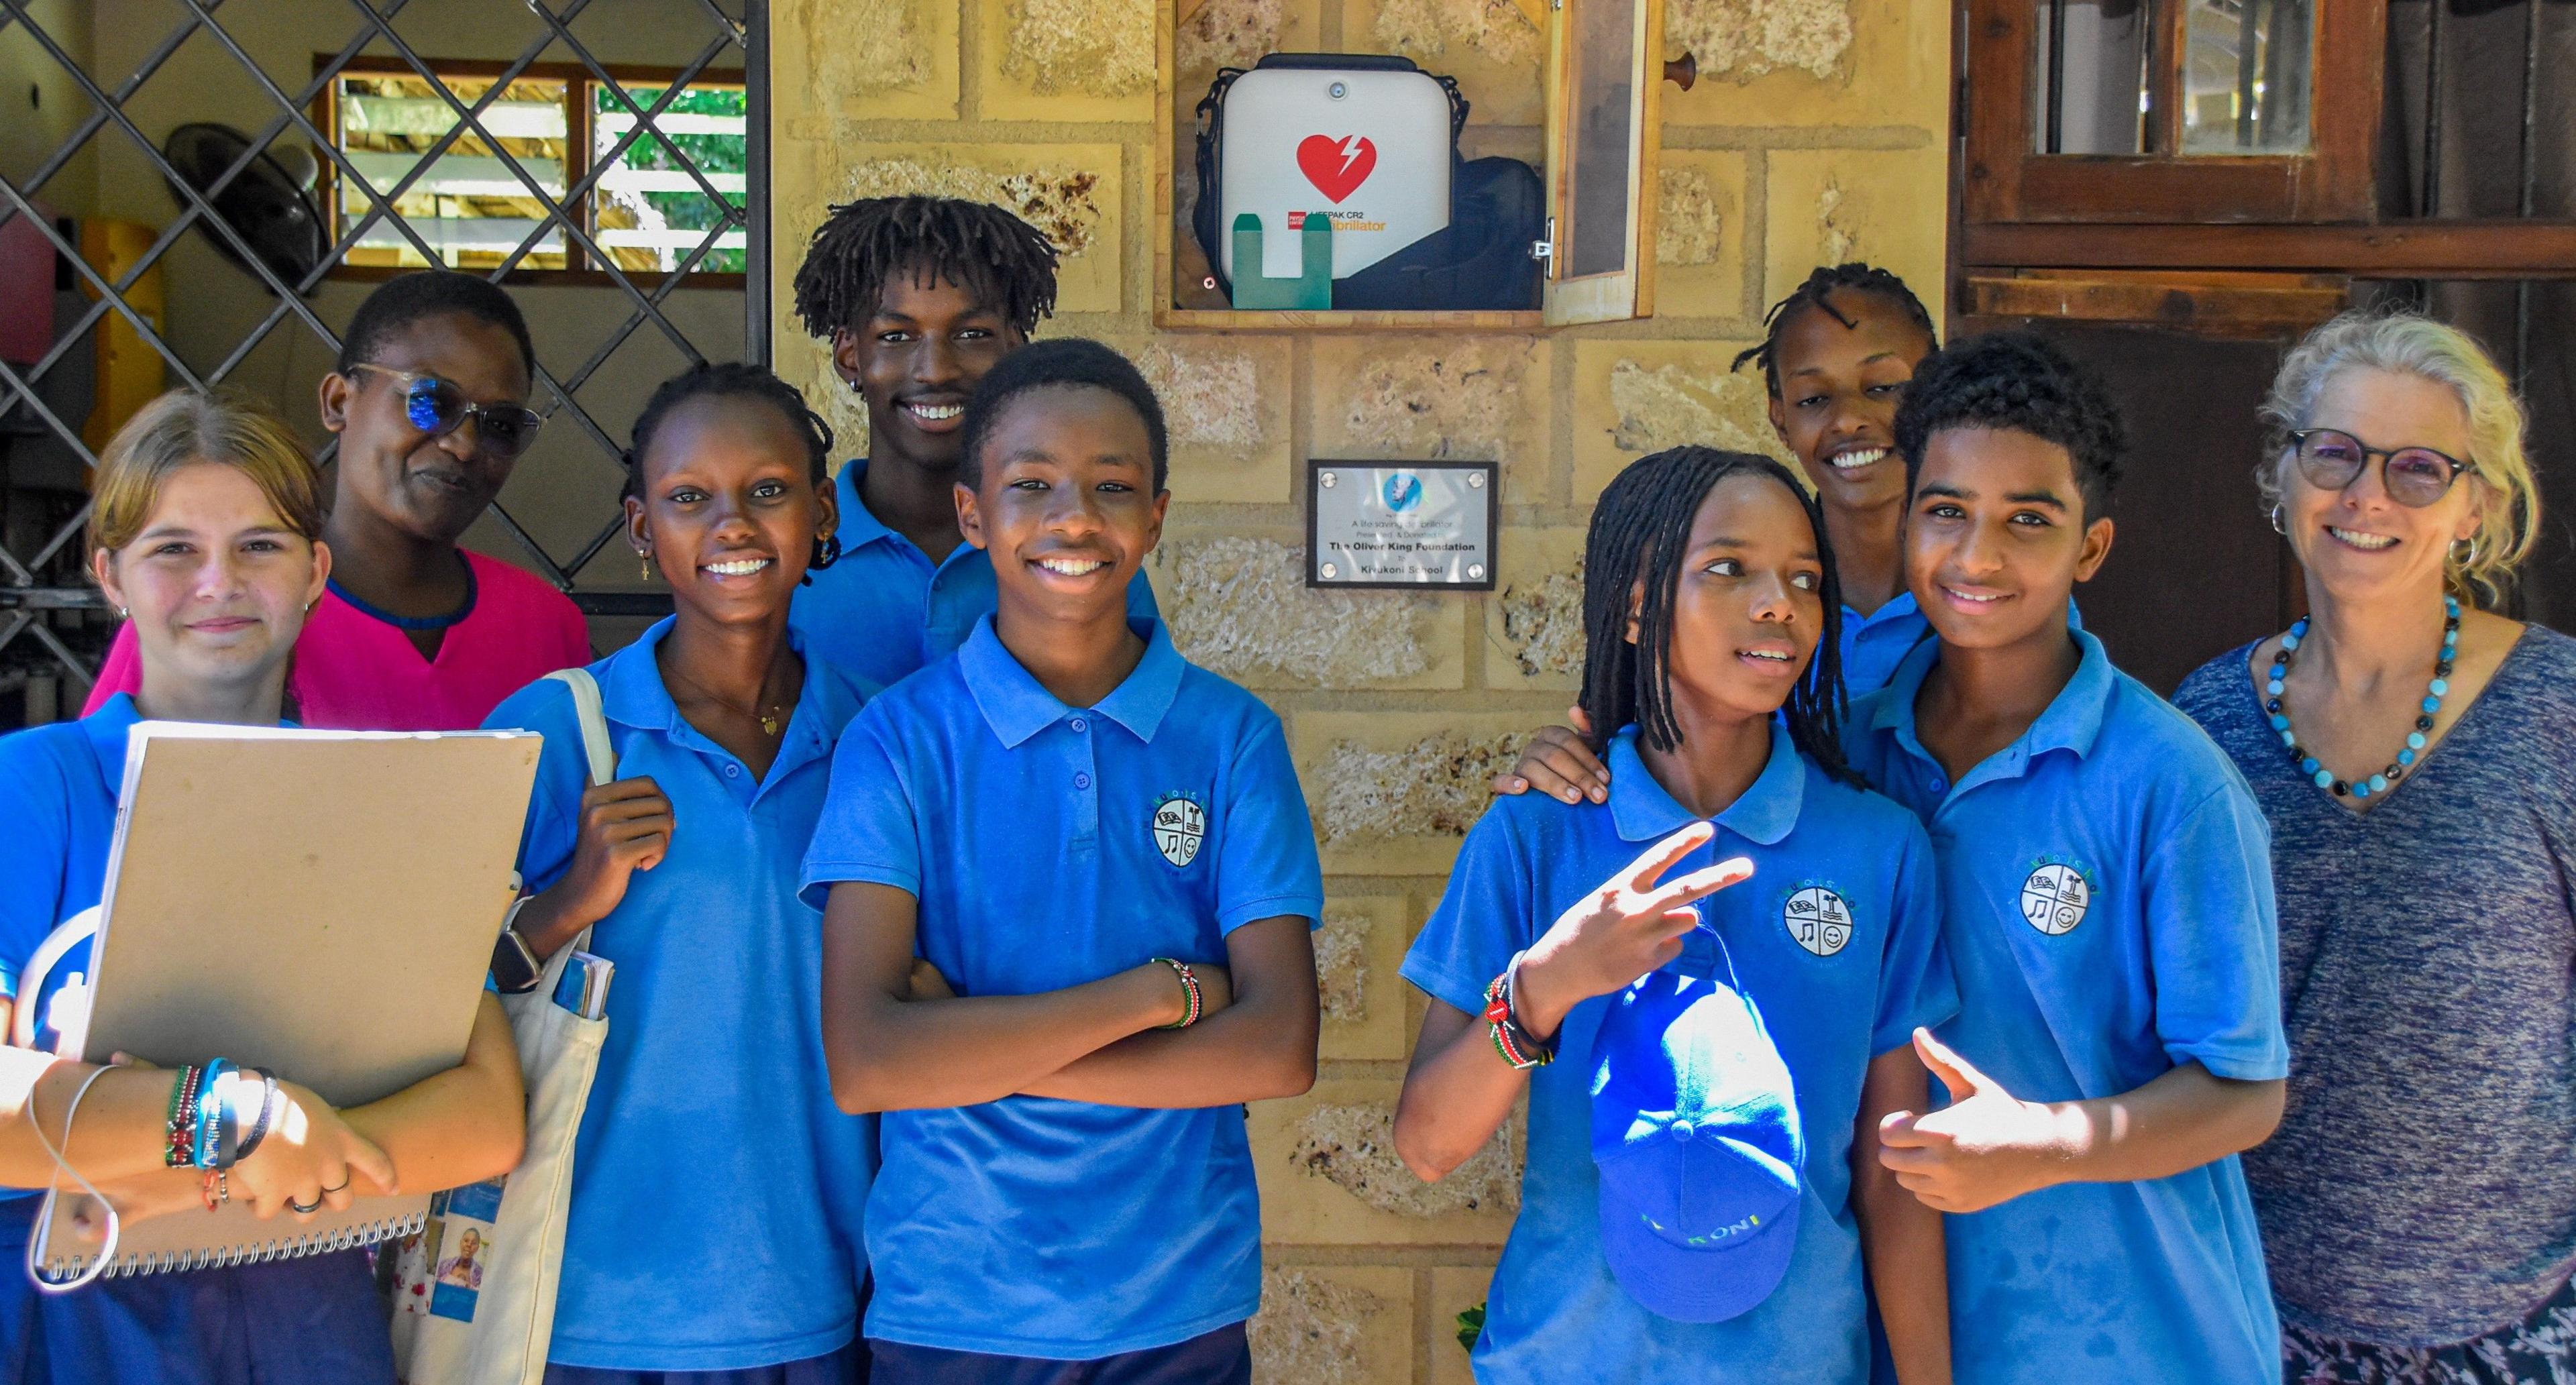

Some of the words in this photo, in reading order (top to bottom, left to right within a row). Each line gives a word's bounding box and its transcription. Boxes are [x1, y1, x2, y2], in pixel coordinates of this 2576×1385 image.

[1346, 211, 1364, 219] CR2
[1332, 220, 1386, 231] ibrillator
[1353, 542, 1385, 551] Oliver
[1388, 543, 1412, 552] King
[1415, 543, 1475, 551] Foundation
